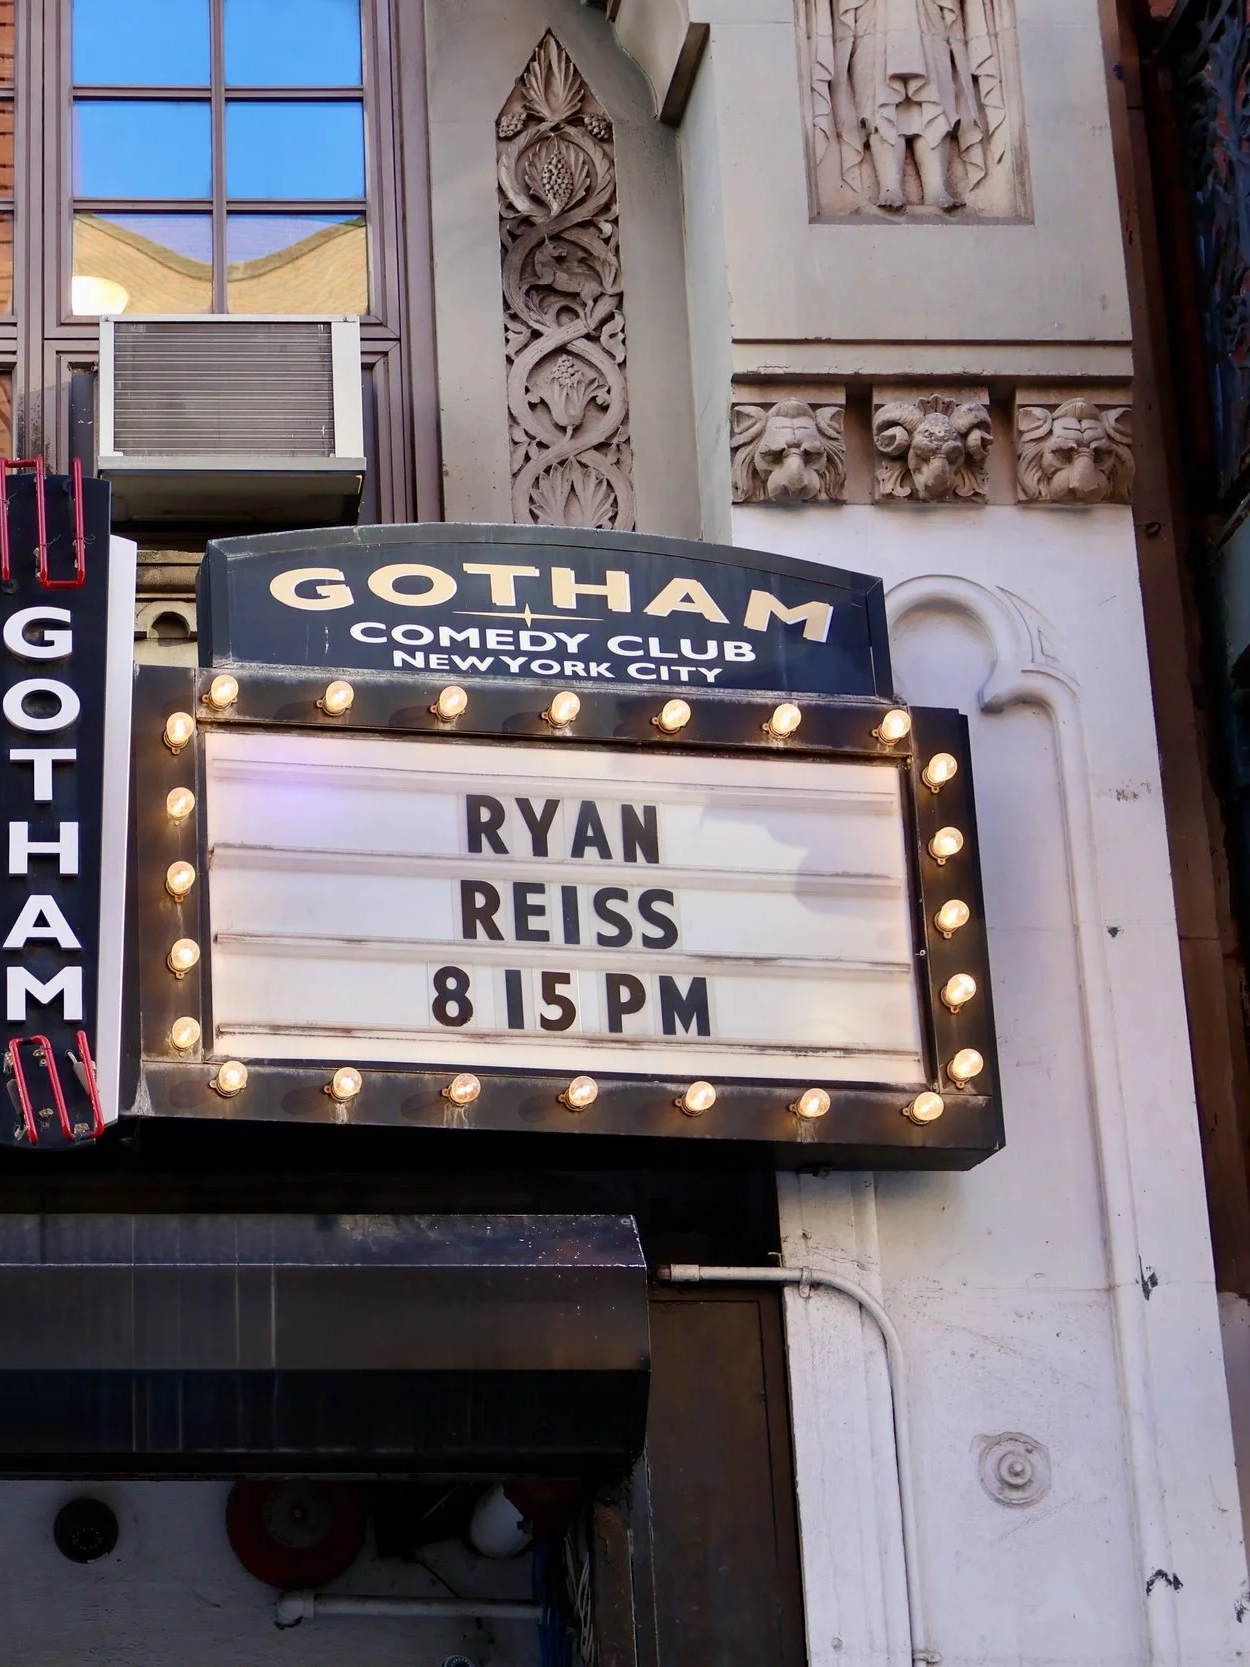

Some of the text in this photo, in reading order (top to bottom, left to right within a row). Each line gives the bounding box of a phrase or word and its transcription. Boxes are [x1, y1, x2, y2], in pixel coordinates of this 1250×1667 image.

[269, 563, 834, 643] GOTHAM
[350, 621, 756, 662] COMEDY CLUB
[393, 650, 723, 683] NEW YORK CITY
[2, 606, 83, 1022] GOTHAM
[465, 794, 661, 865] RYAN
[461, 880, 680, 950] REISS
